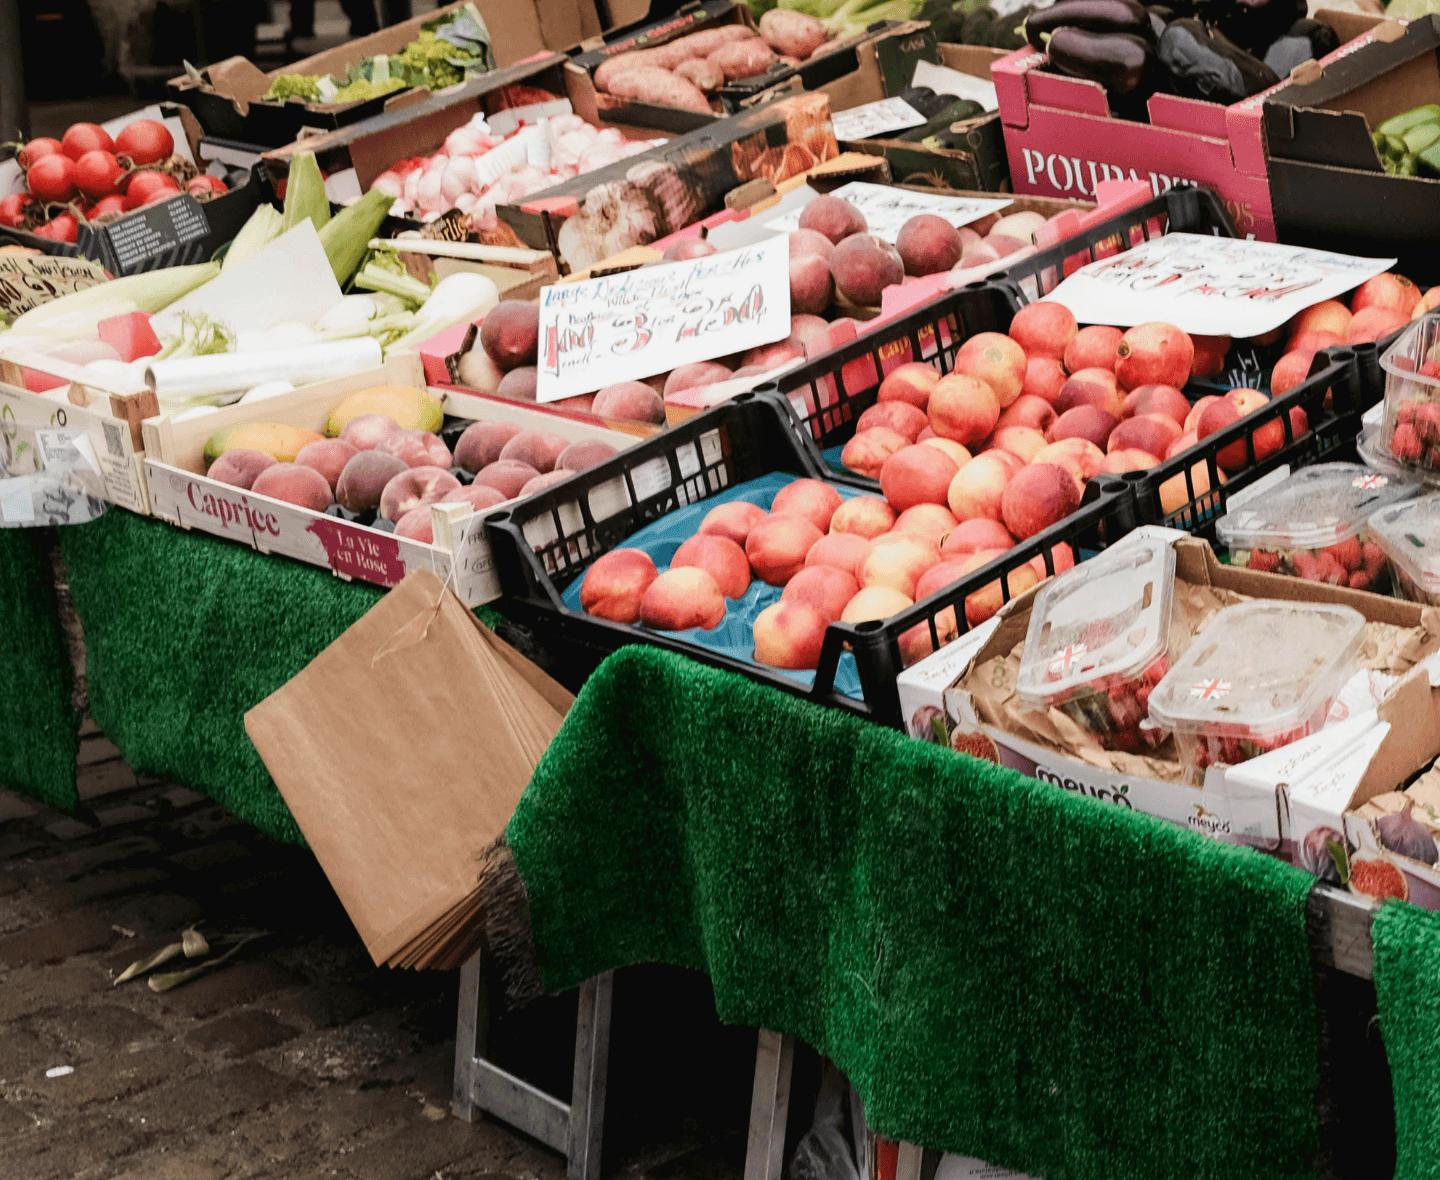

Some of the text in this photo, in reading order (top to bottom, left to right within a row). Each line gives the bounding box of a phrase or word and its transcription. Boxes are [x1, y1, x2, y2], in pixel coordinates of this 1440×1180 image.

[1022, 148, 1201, 196] POUPR
[187, 481, 280, 537] Caprice
[336, 549, 387, 575] en Rose
[337, 531, 380, 557] La Vie
